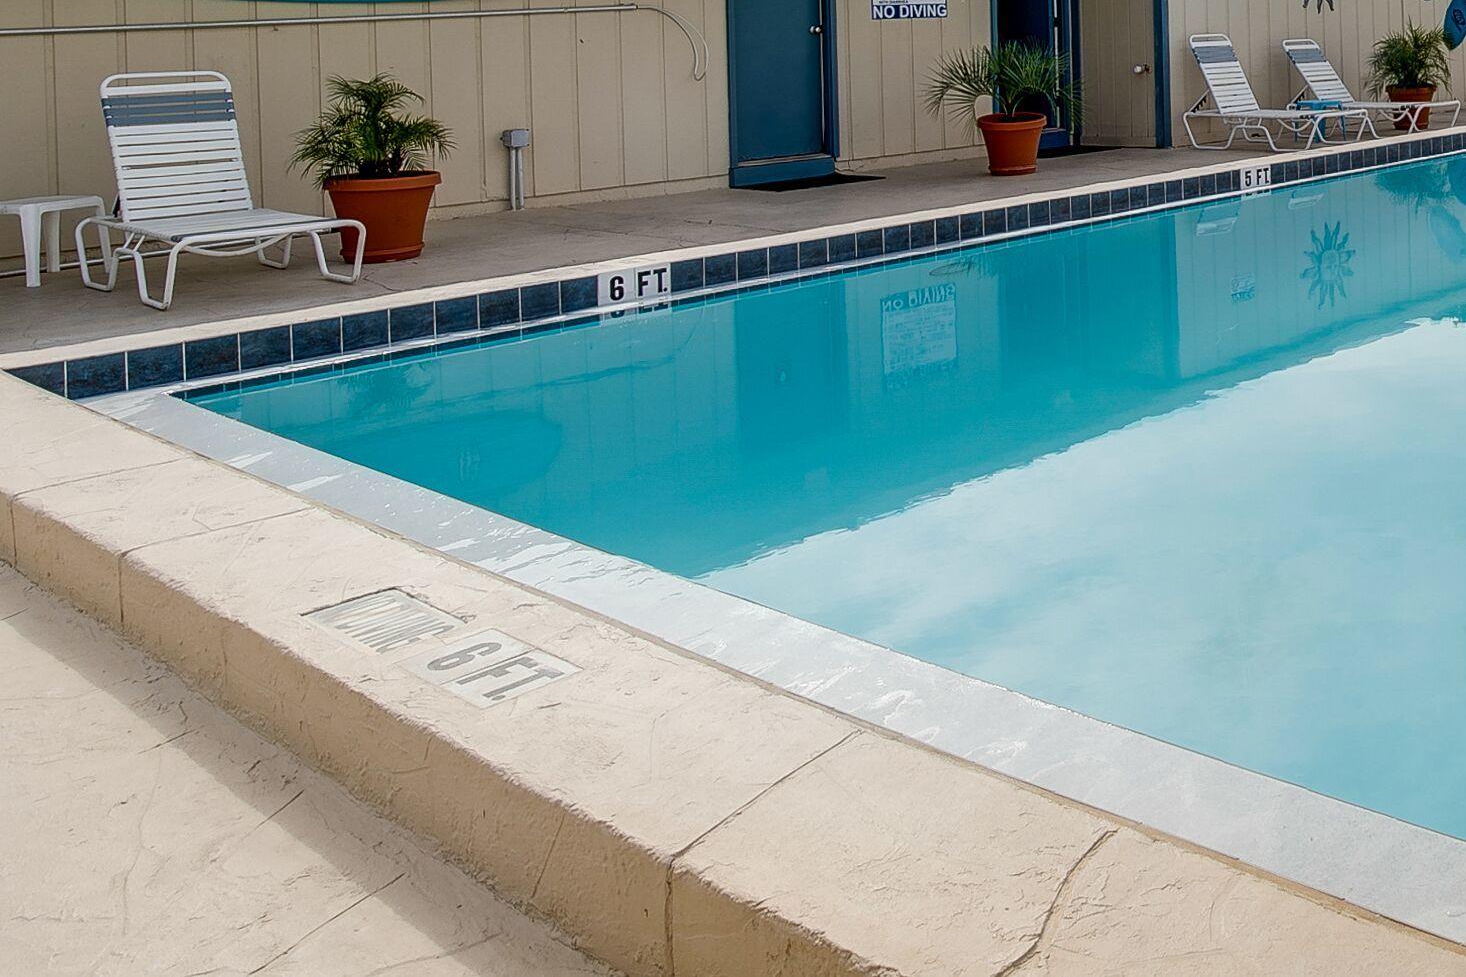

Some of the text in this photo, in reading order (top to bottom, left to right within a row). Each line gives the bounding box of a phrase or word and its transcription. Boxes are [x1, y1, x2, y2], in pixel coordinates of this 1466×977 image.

[873, 4, 947, 19] NO DIVING
[1245, 170, 1252, 187] 5
[609, 267, 668, 301] 6 FT.
[426, 641, 566, 701] 6 FT.
